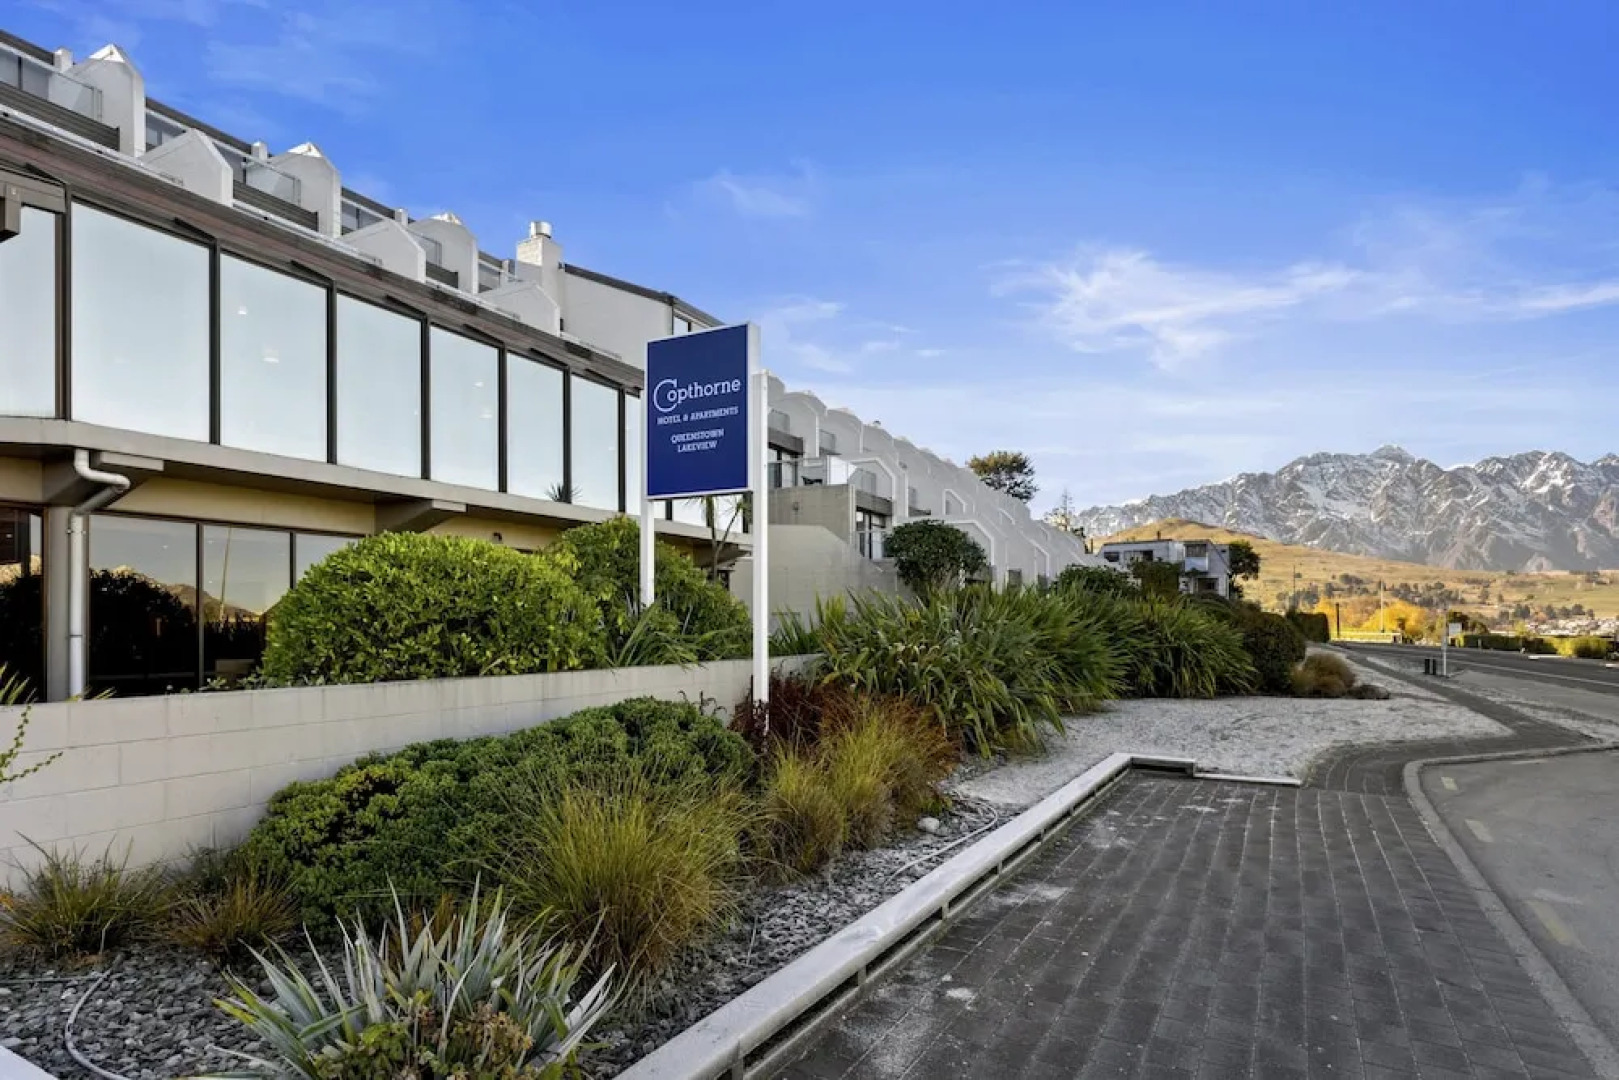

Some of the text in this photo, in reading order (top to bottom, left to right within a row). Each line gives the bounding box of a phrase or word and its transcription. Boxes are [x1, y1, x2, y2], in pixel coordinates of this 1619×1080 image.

[653, 378, 741, 412] Copthorne
[657, 415, 681, 425] HOTEL
[690, 406, 739, 421] APARTMENTS
[671, 428, 725, 444] QUEENSTOWN
[677, 440, 718, 453] LAKEVIEW
